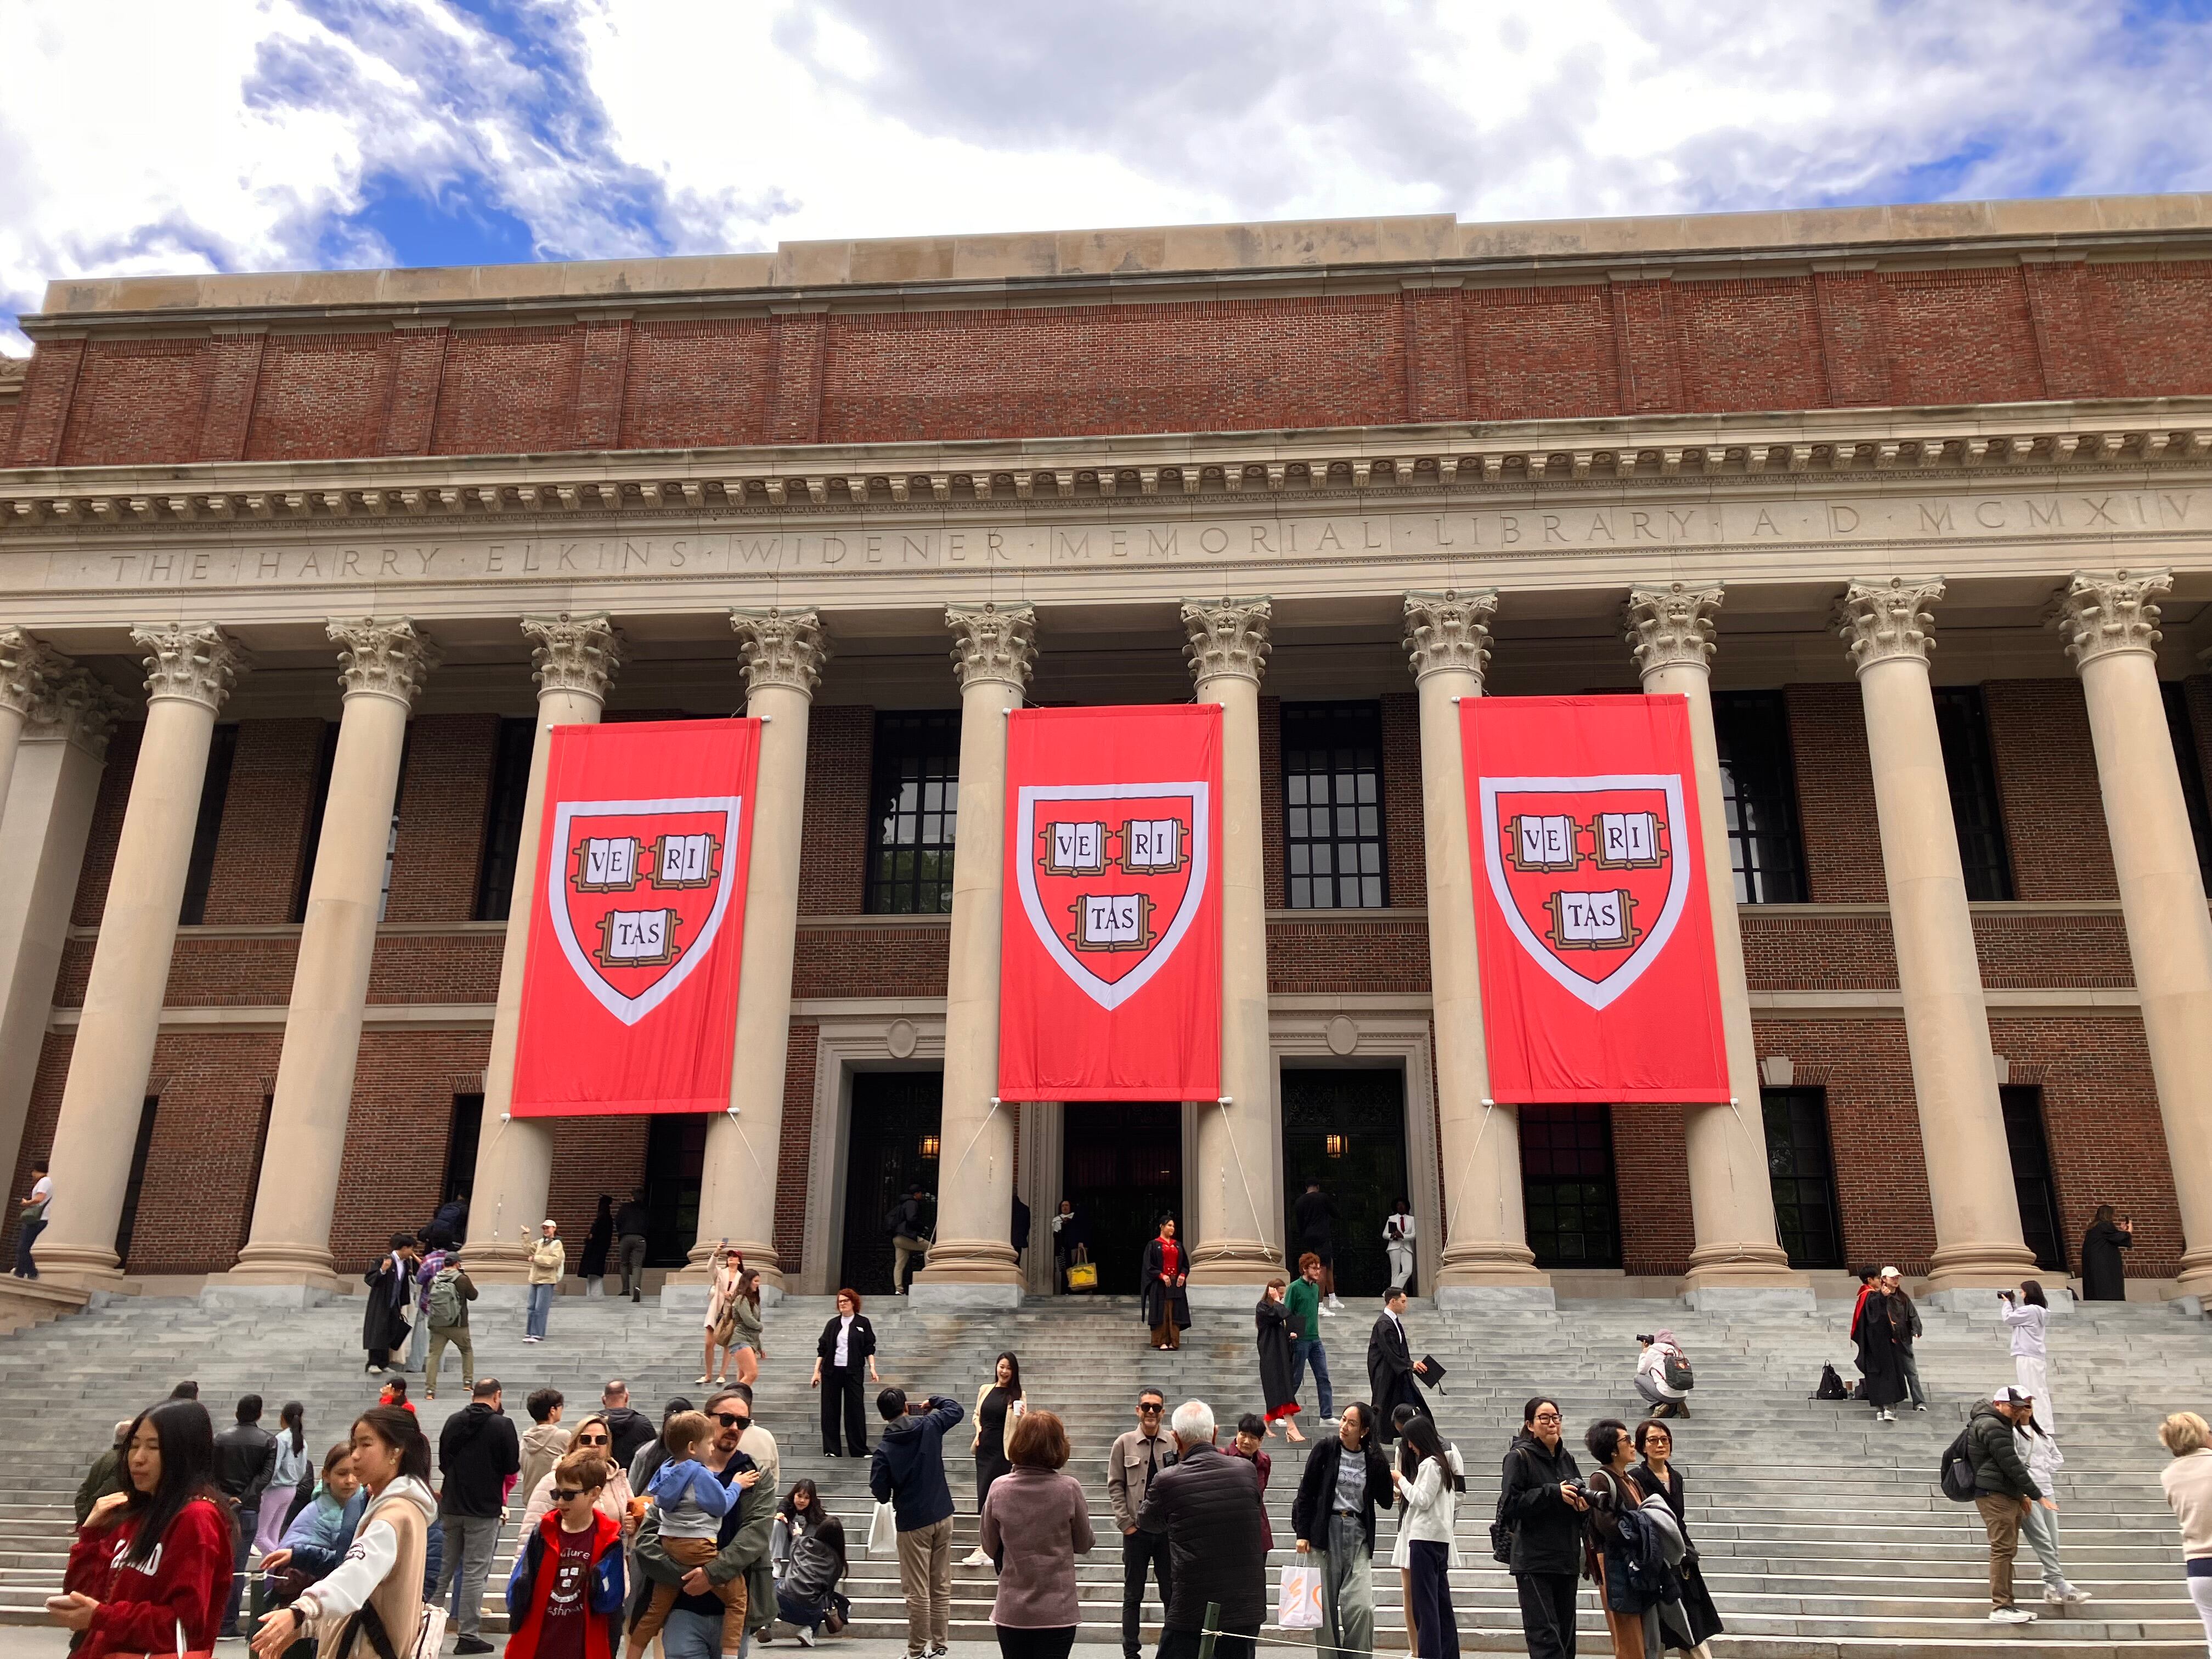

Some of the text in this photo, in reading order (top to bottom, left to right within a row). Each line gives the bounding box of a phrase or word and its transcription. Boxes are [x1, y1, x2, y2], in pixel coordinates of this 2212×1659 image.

[111, 495, 2193, 582] THE HARRY ELKINS WIDENER MEMORIAL LIBRARY A D MCMXIV
[1057, 834, 1163, 856] VE RI
[1523, 827, 1640, 850] VE RI
[590, 848, 695, 871] VE RI
[1091, 906, 1134, 929] TAS
[1567, 904, 1615, 927] TAS
[618, 922, 659, 945] TAS
